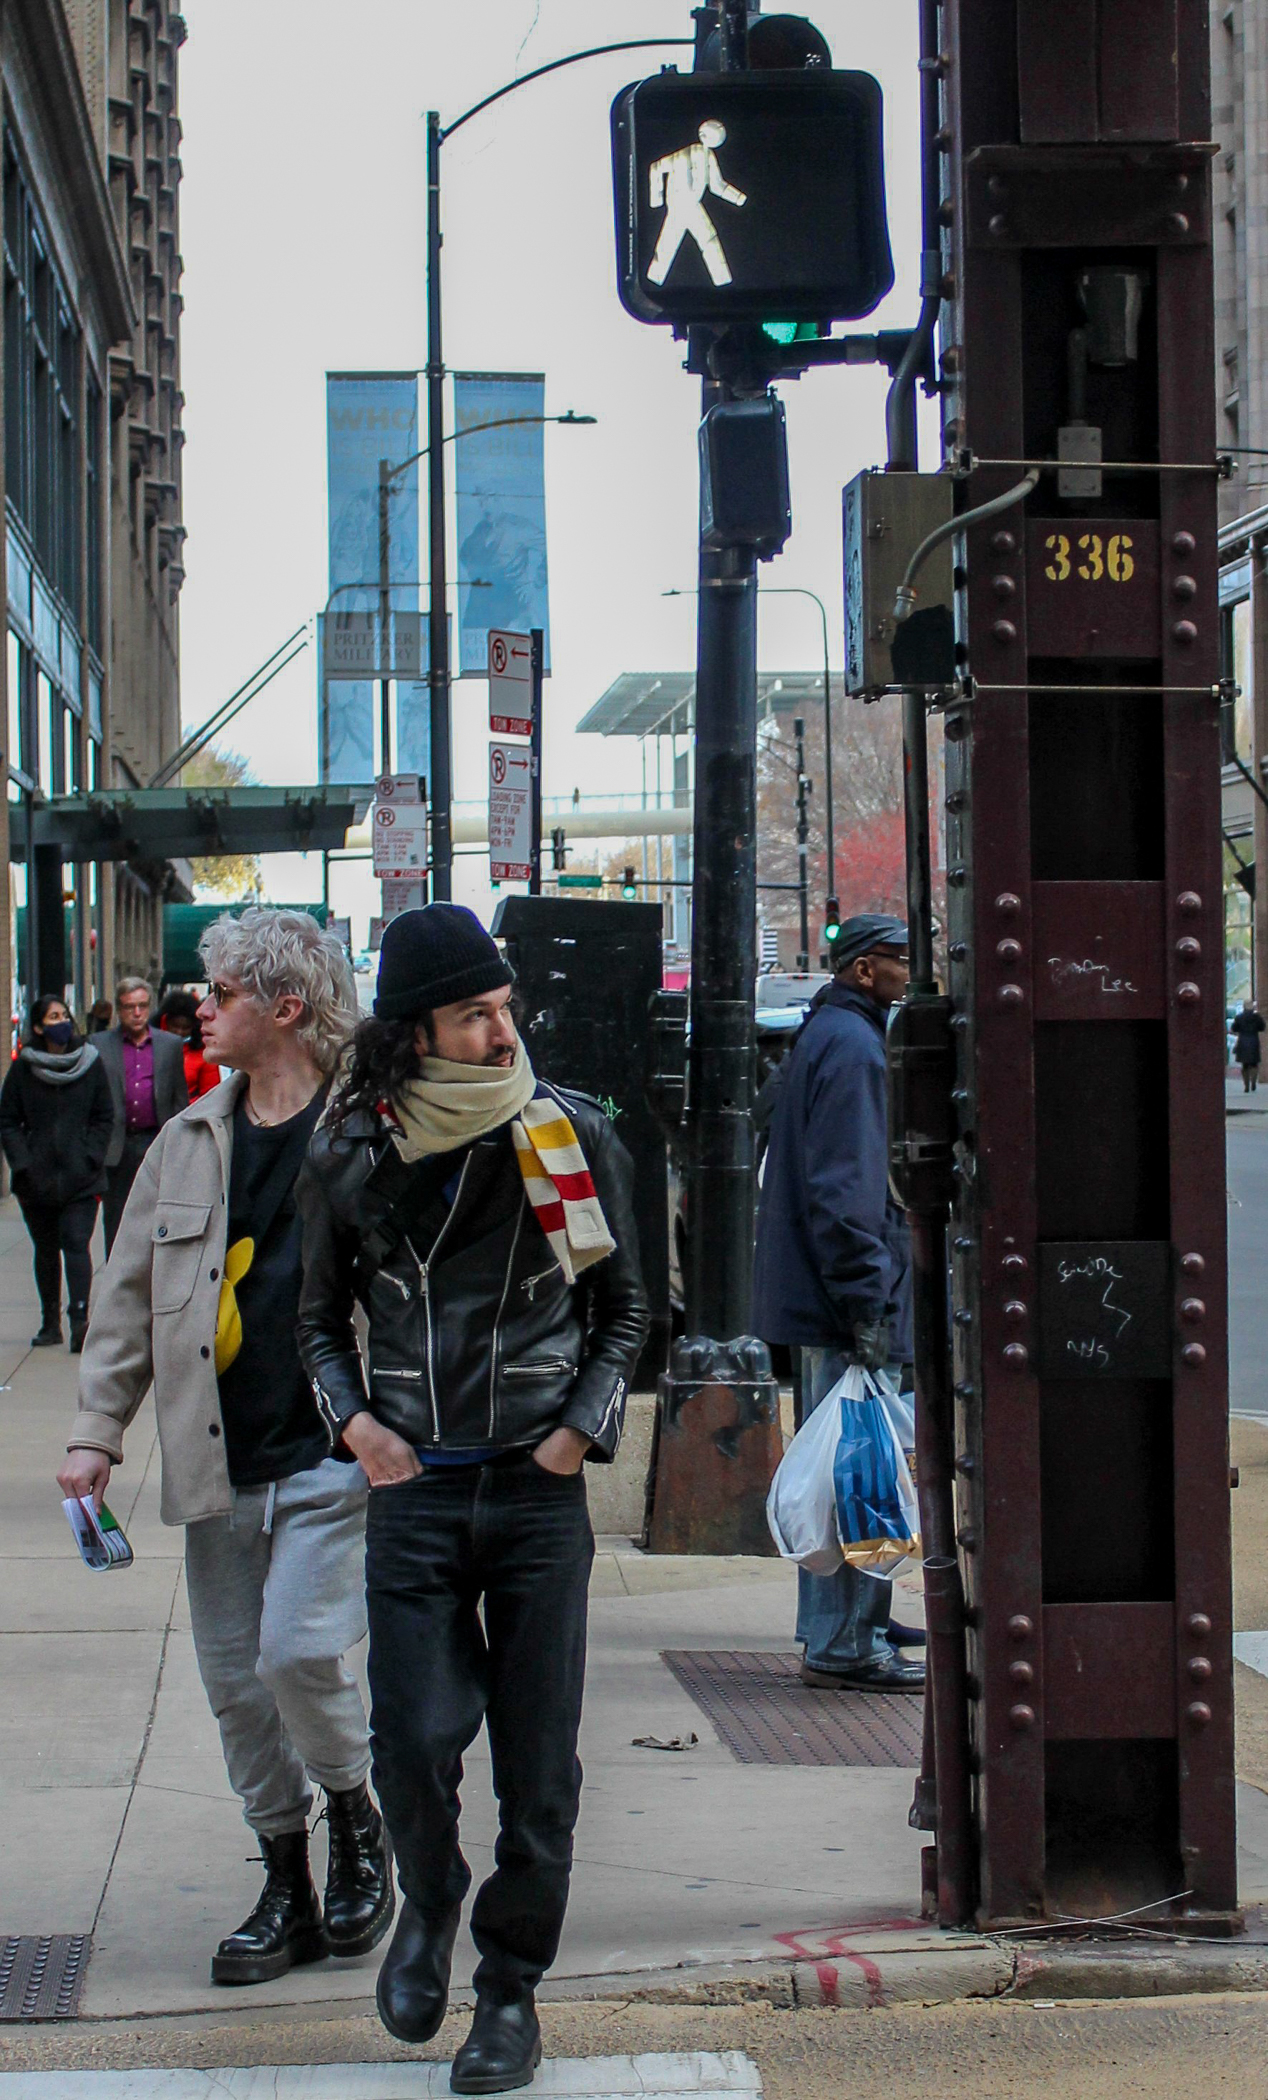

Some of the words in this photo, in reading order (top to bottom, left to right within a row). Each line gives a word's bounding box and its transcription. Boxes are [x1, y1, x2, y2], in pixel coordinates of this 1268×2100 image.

[331, 407, 413, 431] WHO
[458, 408, 540, 433] WHO
[1045, 534, 1134, 581] 336
[494, 717, 507, 731] TOW
[510, 719, 528, 733] ZONE
[492, 863, 506, 876] TOW
[508, 865, 527, 877] ZONE
